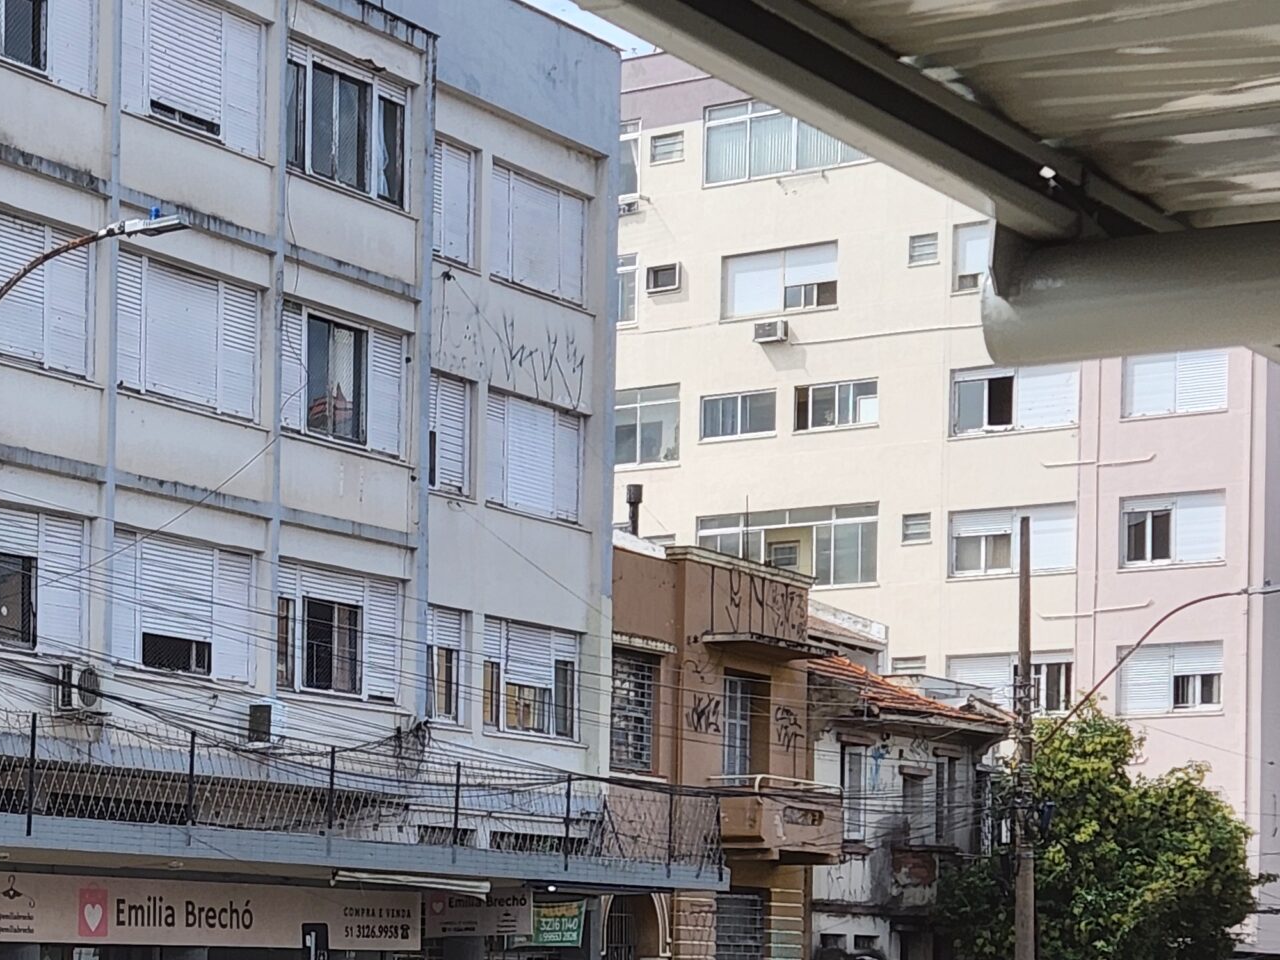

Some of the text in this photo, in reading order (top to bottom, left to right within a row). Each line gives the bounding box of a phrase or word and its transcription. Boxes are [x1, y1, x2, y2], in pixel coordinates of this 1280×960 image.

[486, 894, 527, 907] Brechó
[116, 896, 253, 929] Emilia Brechó
[344, 907, 376, 917] COMPRA
[386, 908, 411, 918] VENDA
[345, 924, 398, 939] 51 3126.9958
